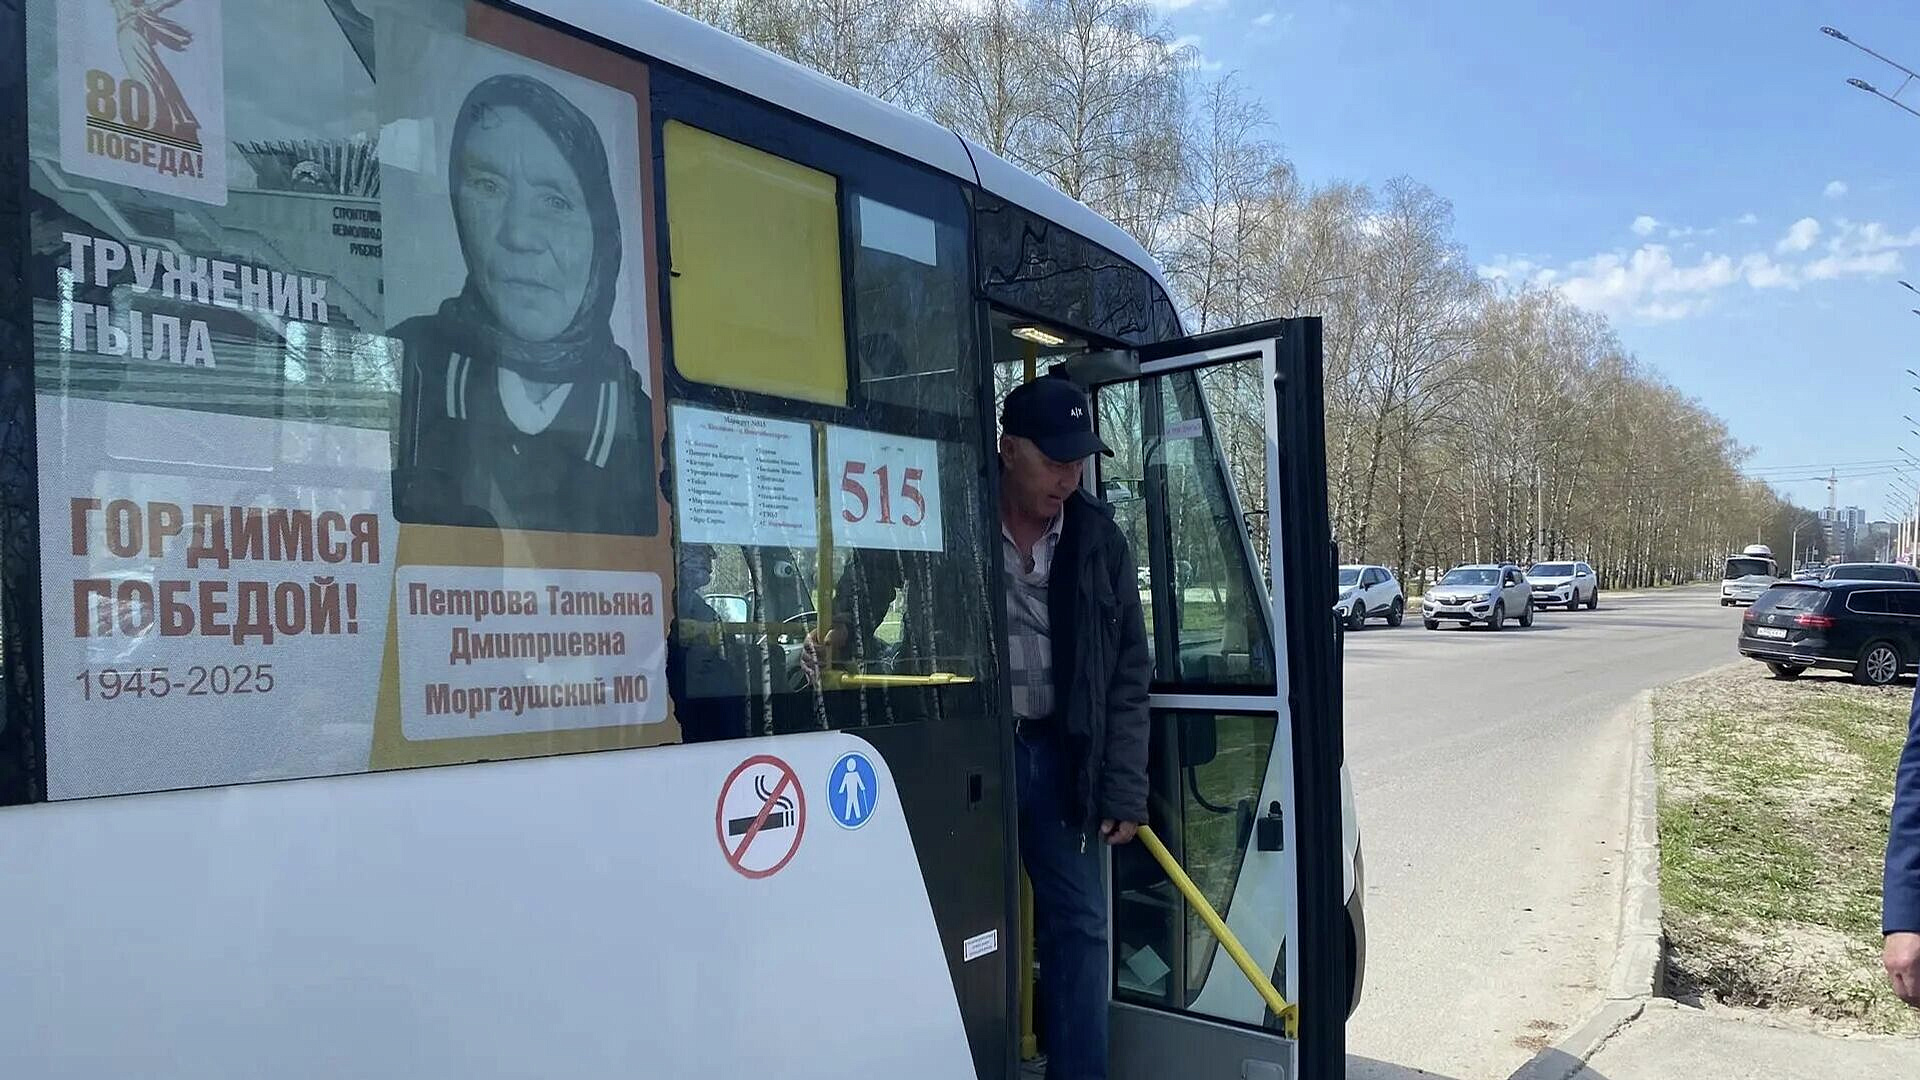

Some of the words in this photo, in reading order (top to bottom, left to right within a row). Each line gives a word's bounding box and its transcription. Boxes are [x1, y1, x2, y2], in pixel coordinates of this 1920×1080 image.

[86, 68, 151, 130] 80
[86, 128, 205, 180] ПОБЕДА!
[61, 232, 330, 324] ТРУЖЕНИК
[67, 300, 217, 369] ТЫЛА
[841, 460, 926, 527] 515
[70, 497, 380, 569] ГОРДИМСЯ
[73, 576, 359, 645] ПОБЕДОЙ!
[408, 582, 538, 622] Петрова
[546, 585, 654, 616] Татьяна
[449, 627, 626, 665] Дмитриевна
[76, 663, 275, 701] 1945-2025
[425, 676, 606, 719] Моргаушский
[613, 674, 649, 704] МО
